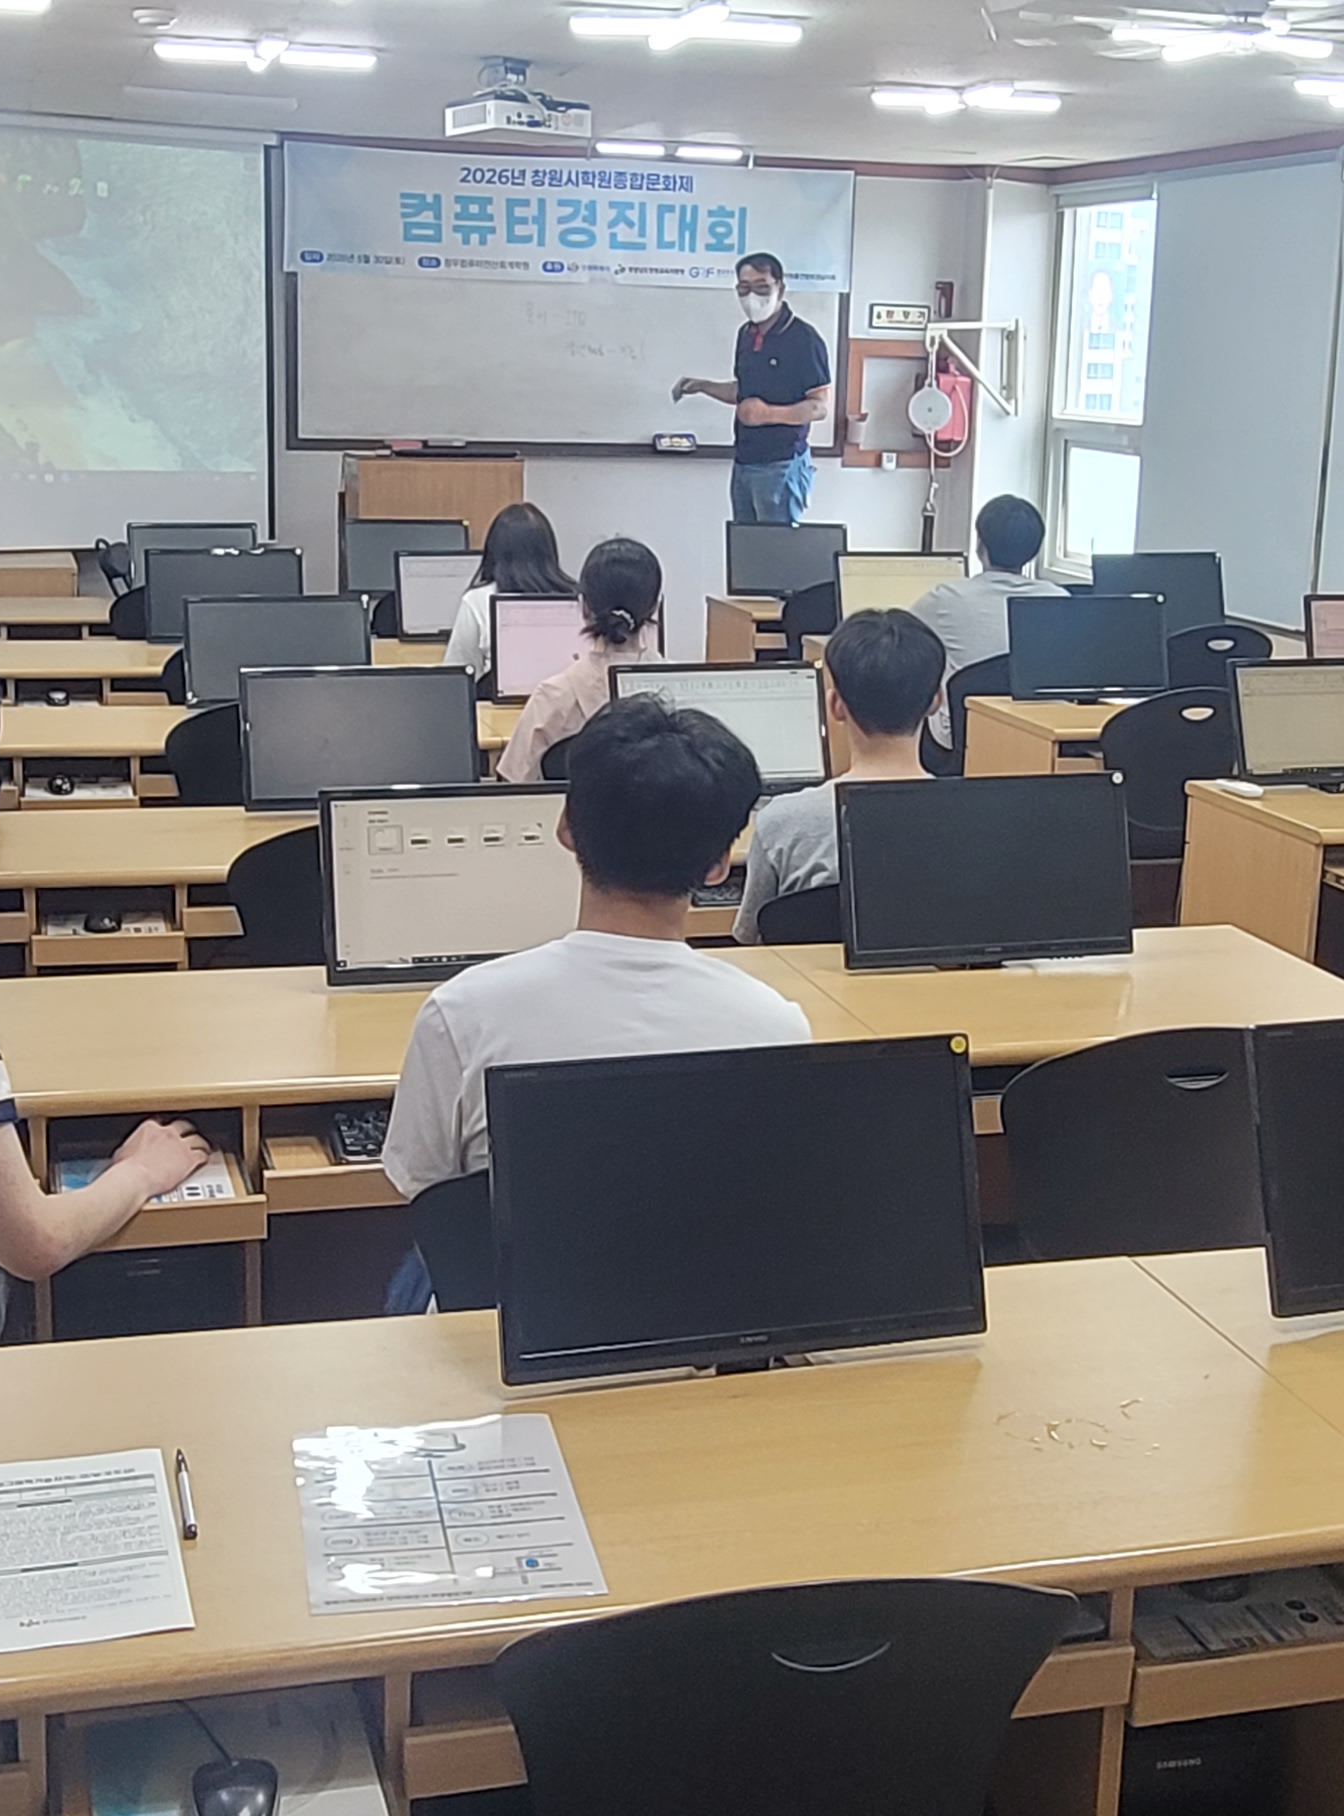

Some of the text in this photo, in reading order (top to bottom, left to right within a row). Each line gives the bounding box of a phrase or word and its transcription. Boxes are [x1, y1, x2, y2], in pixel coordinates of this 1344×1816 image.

[459, 167, 694, 193] 2026년 창원시학원종합문화제
[399, 192, 748, 255] 컴퓨터경진대회
